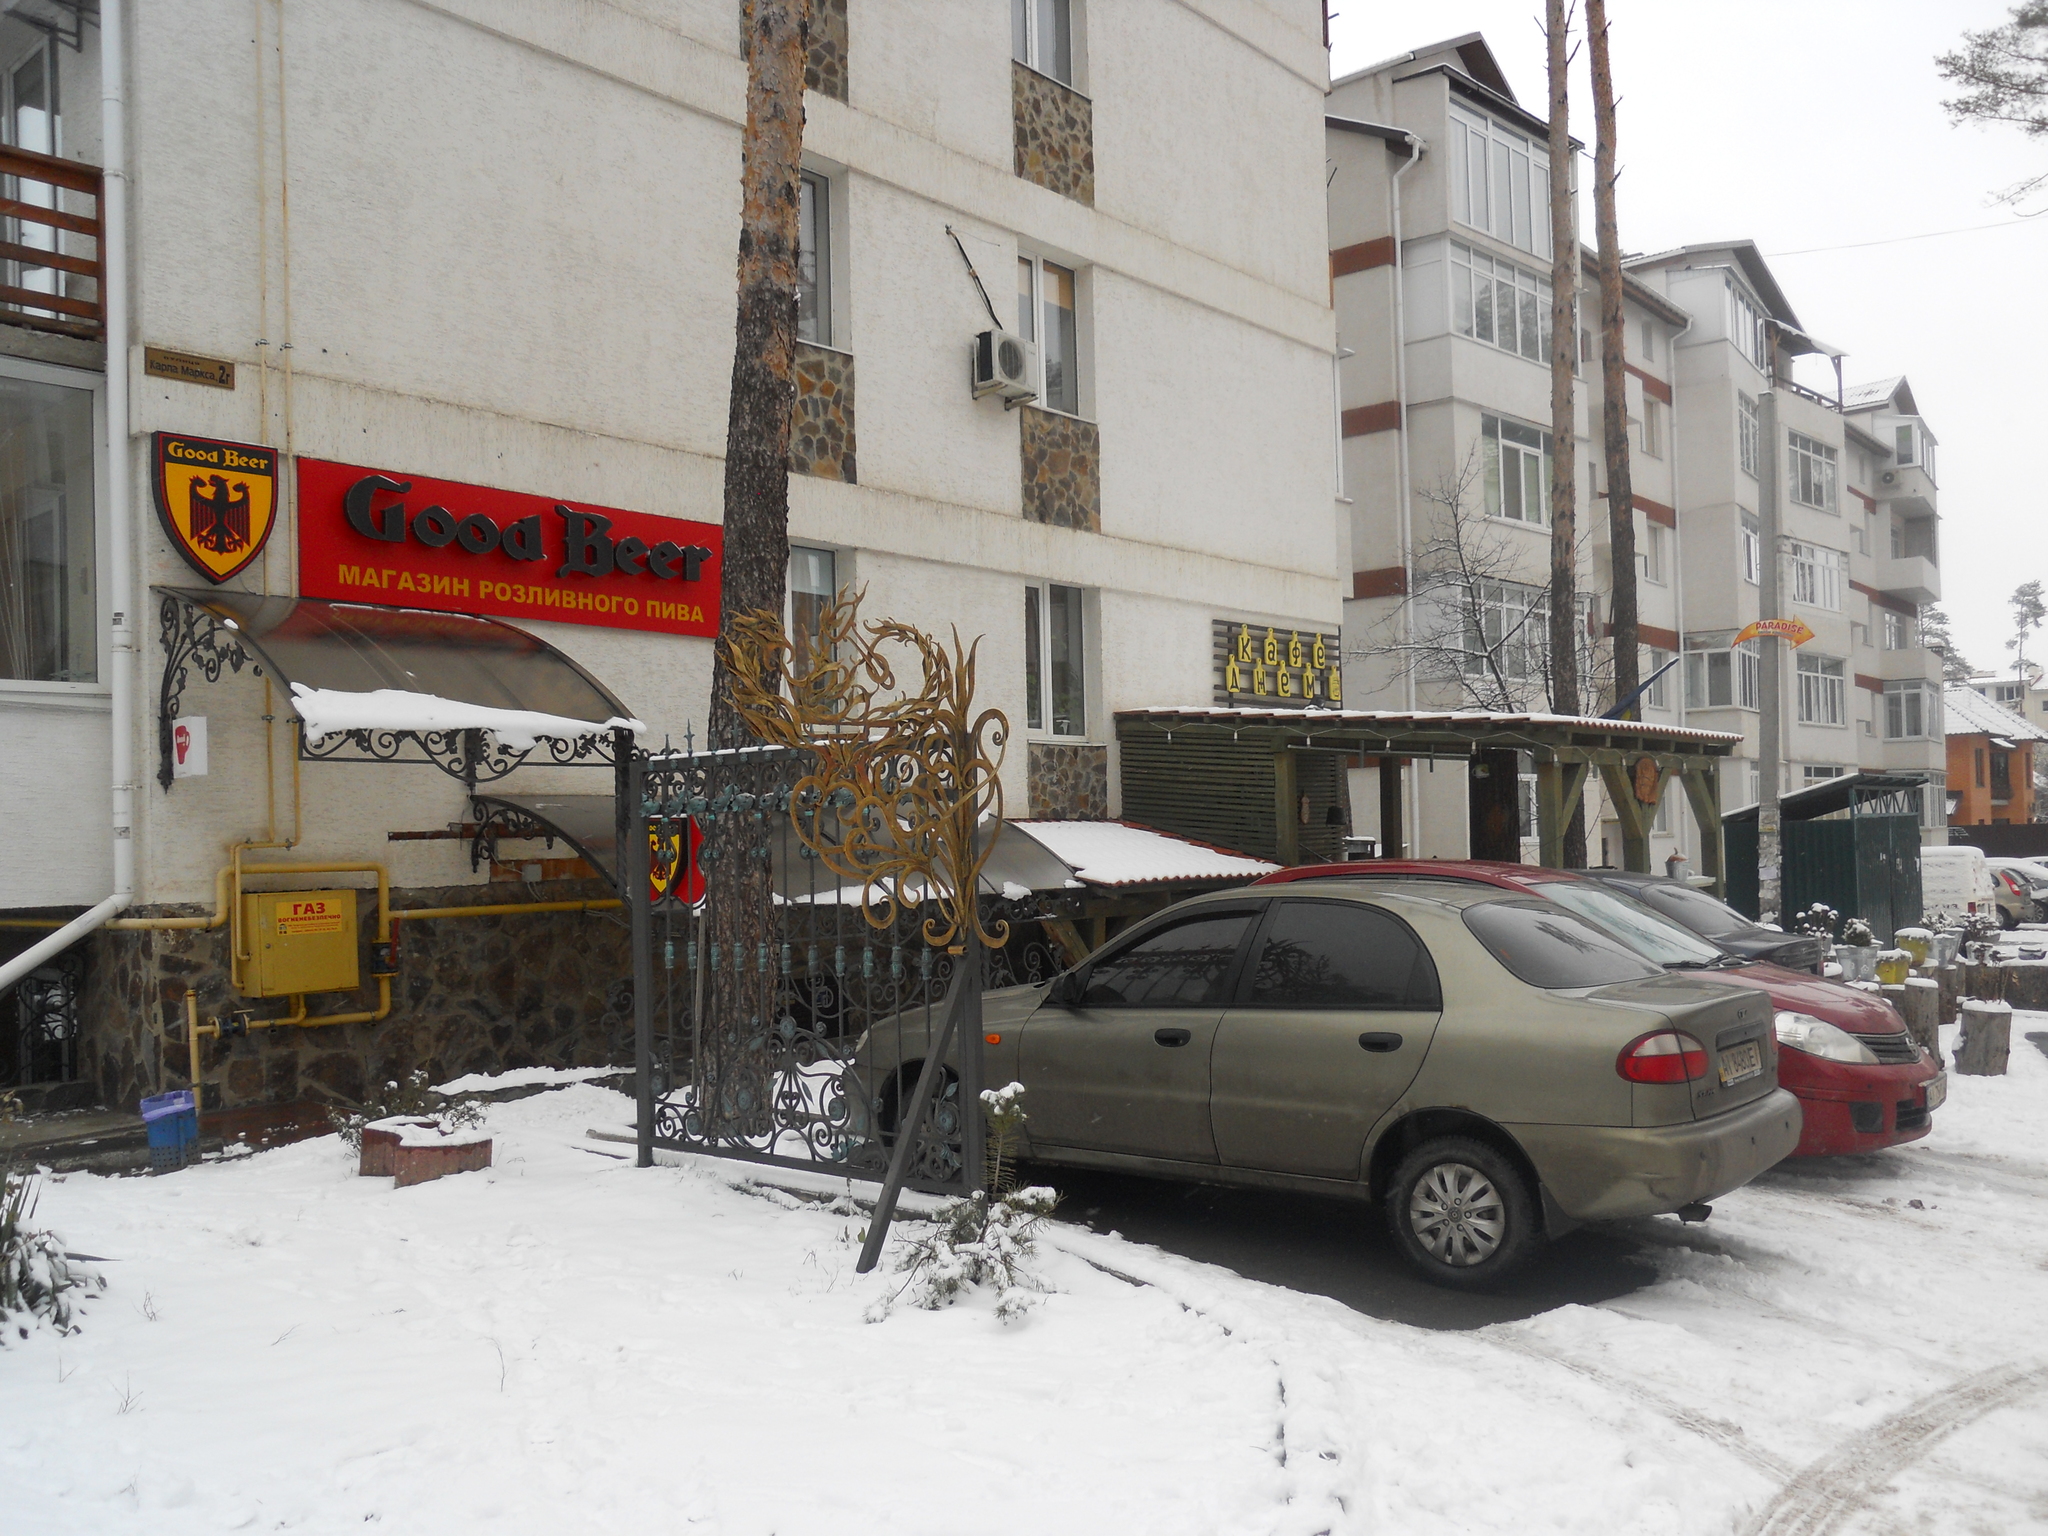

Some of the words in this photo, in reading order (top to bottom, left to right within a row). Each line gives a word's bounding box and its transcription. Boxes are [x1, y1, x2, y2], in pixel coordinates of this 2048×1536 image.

[149, 360, 179, 375] Карла
[167, 441, 219, 463] Good
[222, 448, 269, 470] Beer
[343, 474, 548, 563] Good
[553, 504, 713, 582] Beer
[338, 563, 470, 598] МАГАЗИН
[479, 579, 640, 616] РОЗЛИВНОГО
[645, 600, 705, 623] ПИВА
[1756, 622, 1804, 634] PARADISE
[293, 903, 326, 915] ГАЗ
